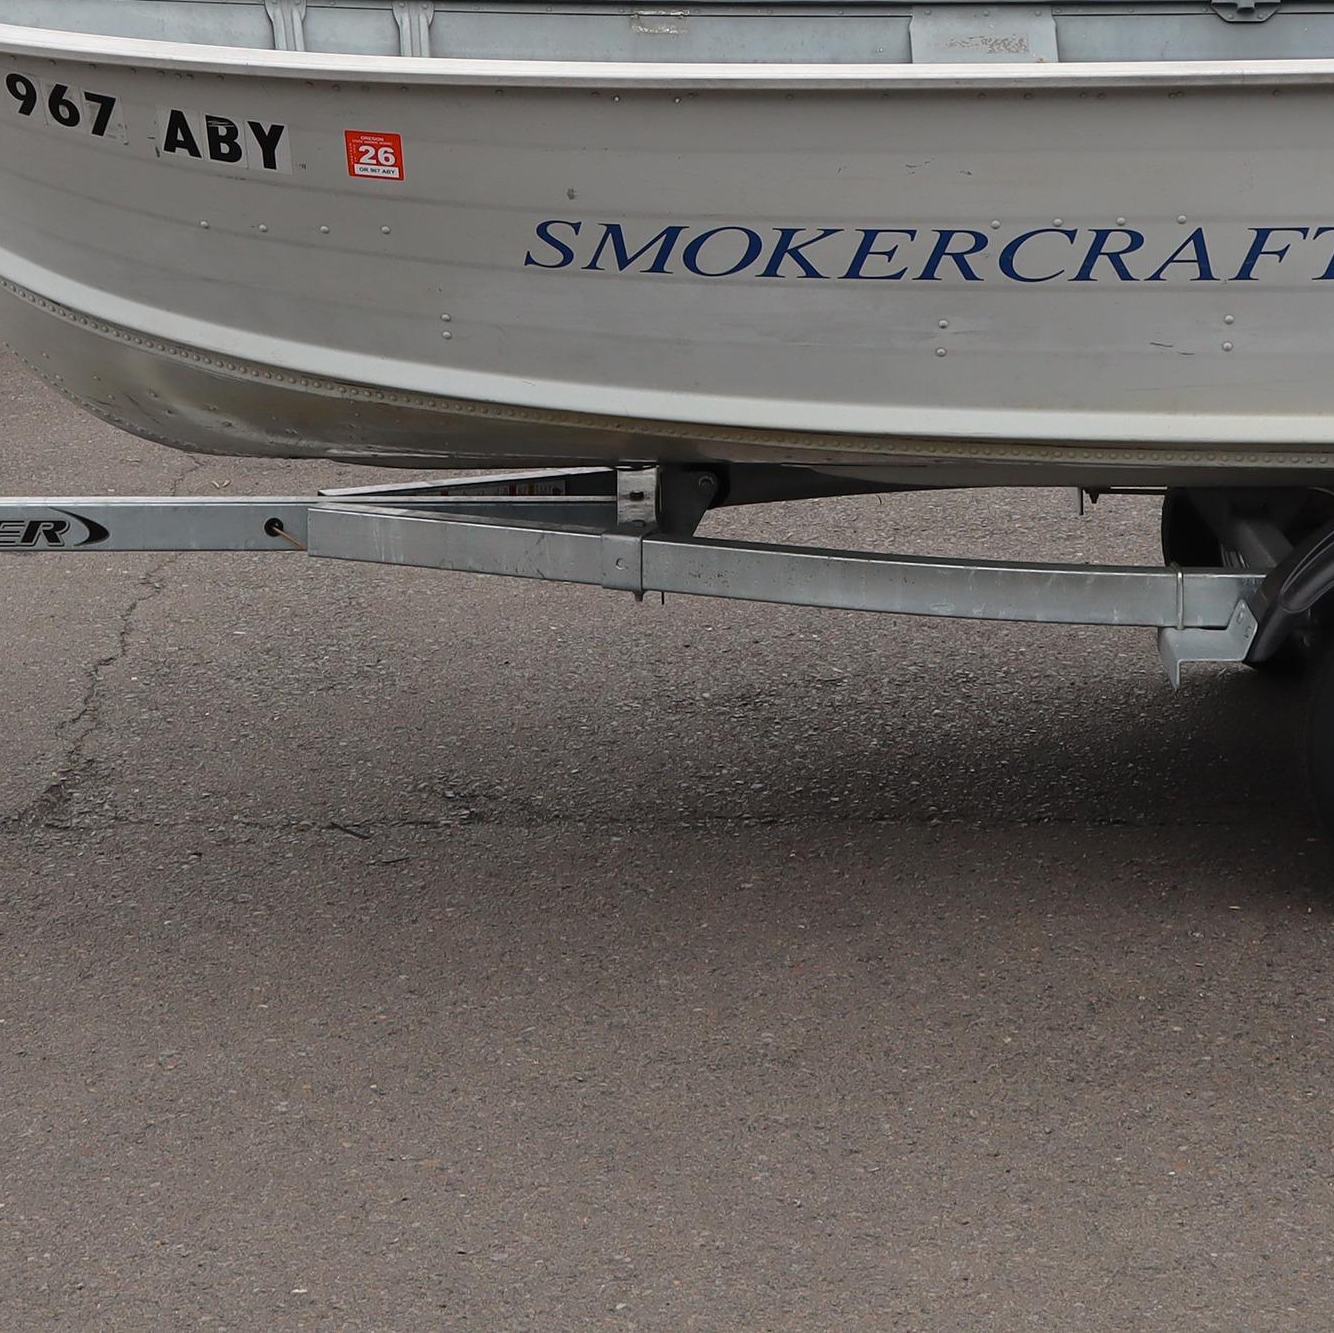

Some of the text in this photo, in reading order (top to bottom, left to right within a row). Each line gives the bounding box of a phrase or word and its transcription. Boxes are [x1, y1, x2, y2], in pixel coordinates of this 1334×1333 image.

[6, 73, 117, 137] 967
[163, 109, 285, 170] ABY
[358, 145, 396, 166] 26
